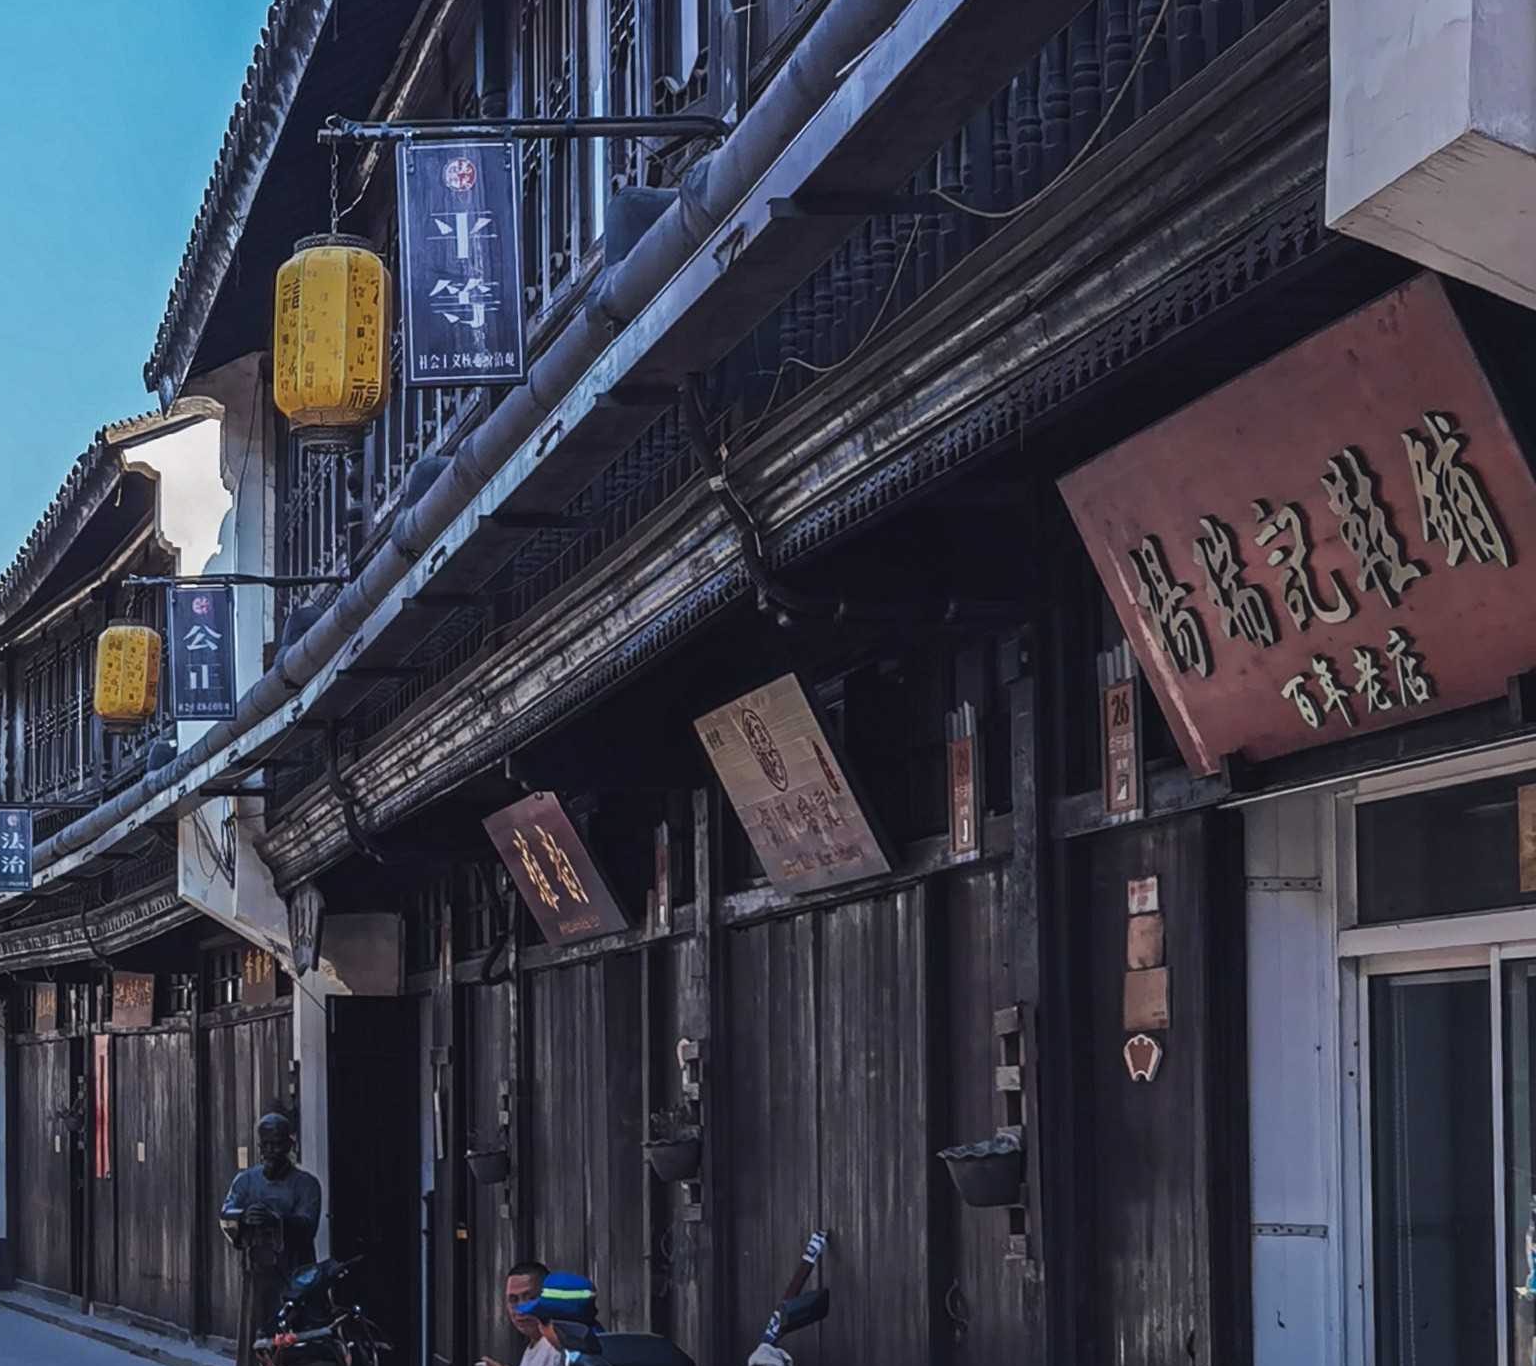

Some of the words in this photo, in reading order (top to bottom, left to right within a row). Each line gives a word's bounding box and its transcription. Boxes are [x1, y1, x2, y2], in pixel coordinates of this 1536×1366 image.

[426, 211, 501, 328] 平等
[183, 625, 224, 690] 公正
[1280, 630, 1431, 730] 百年老店
[1, 831, 26, 875] 法治
